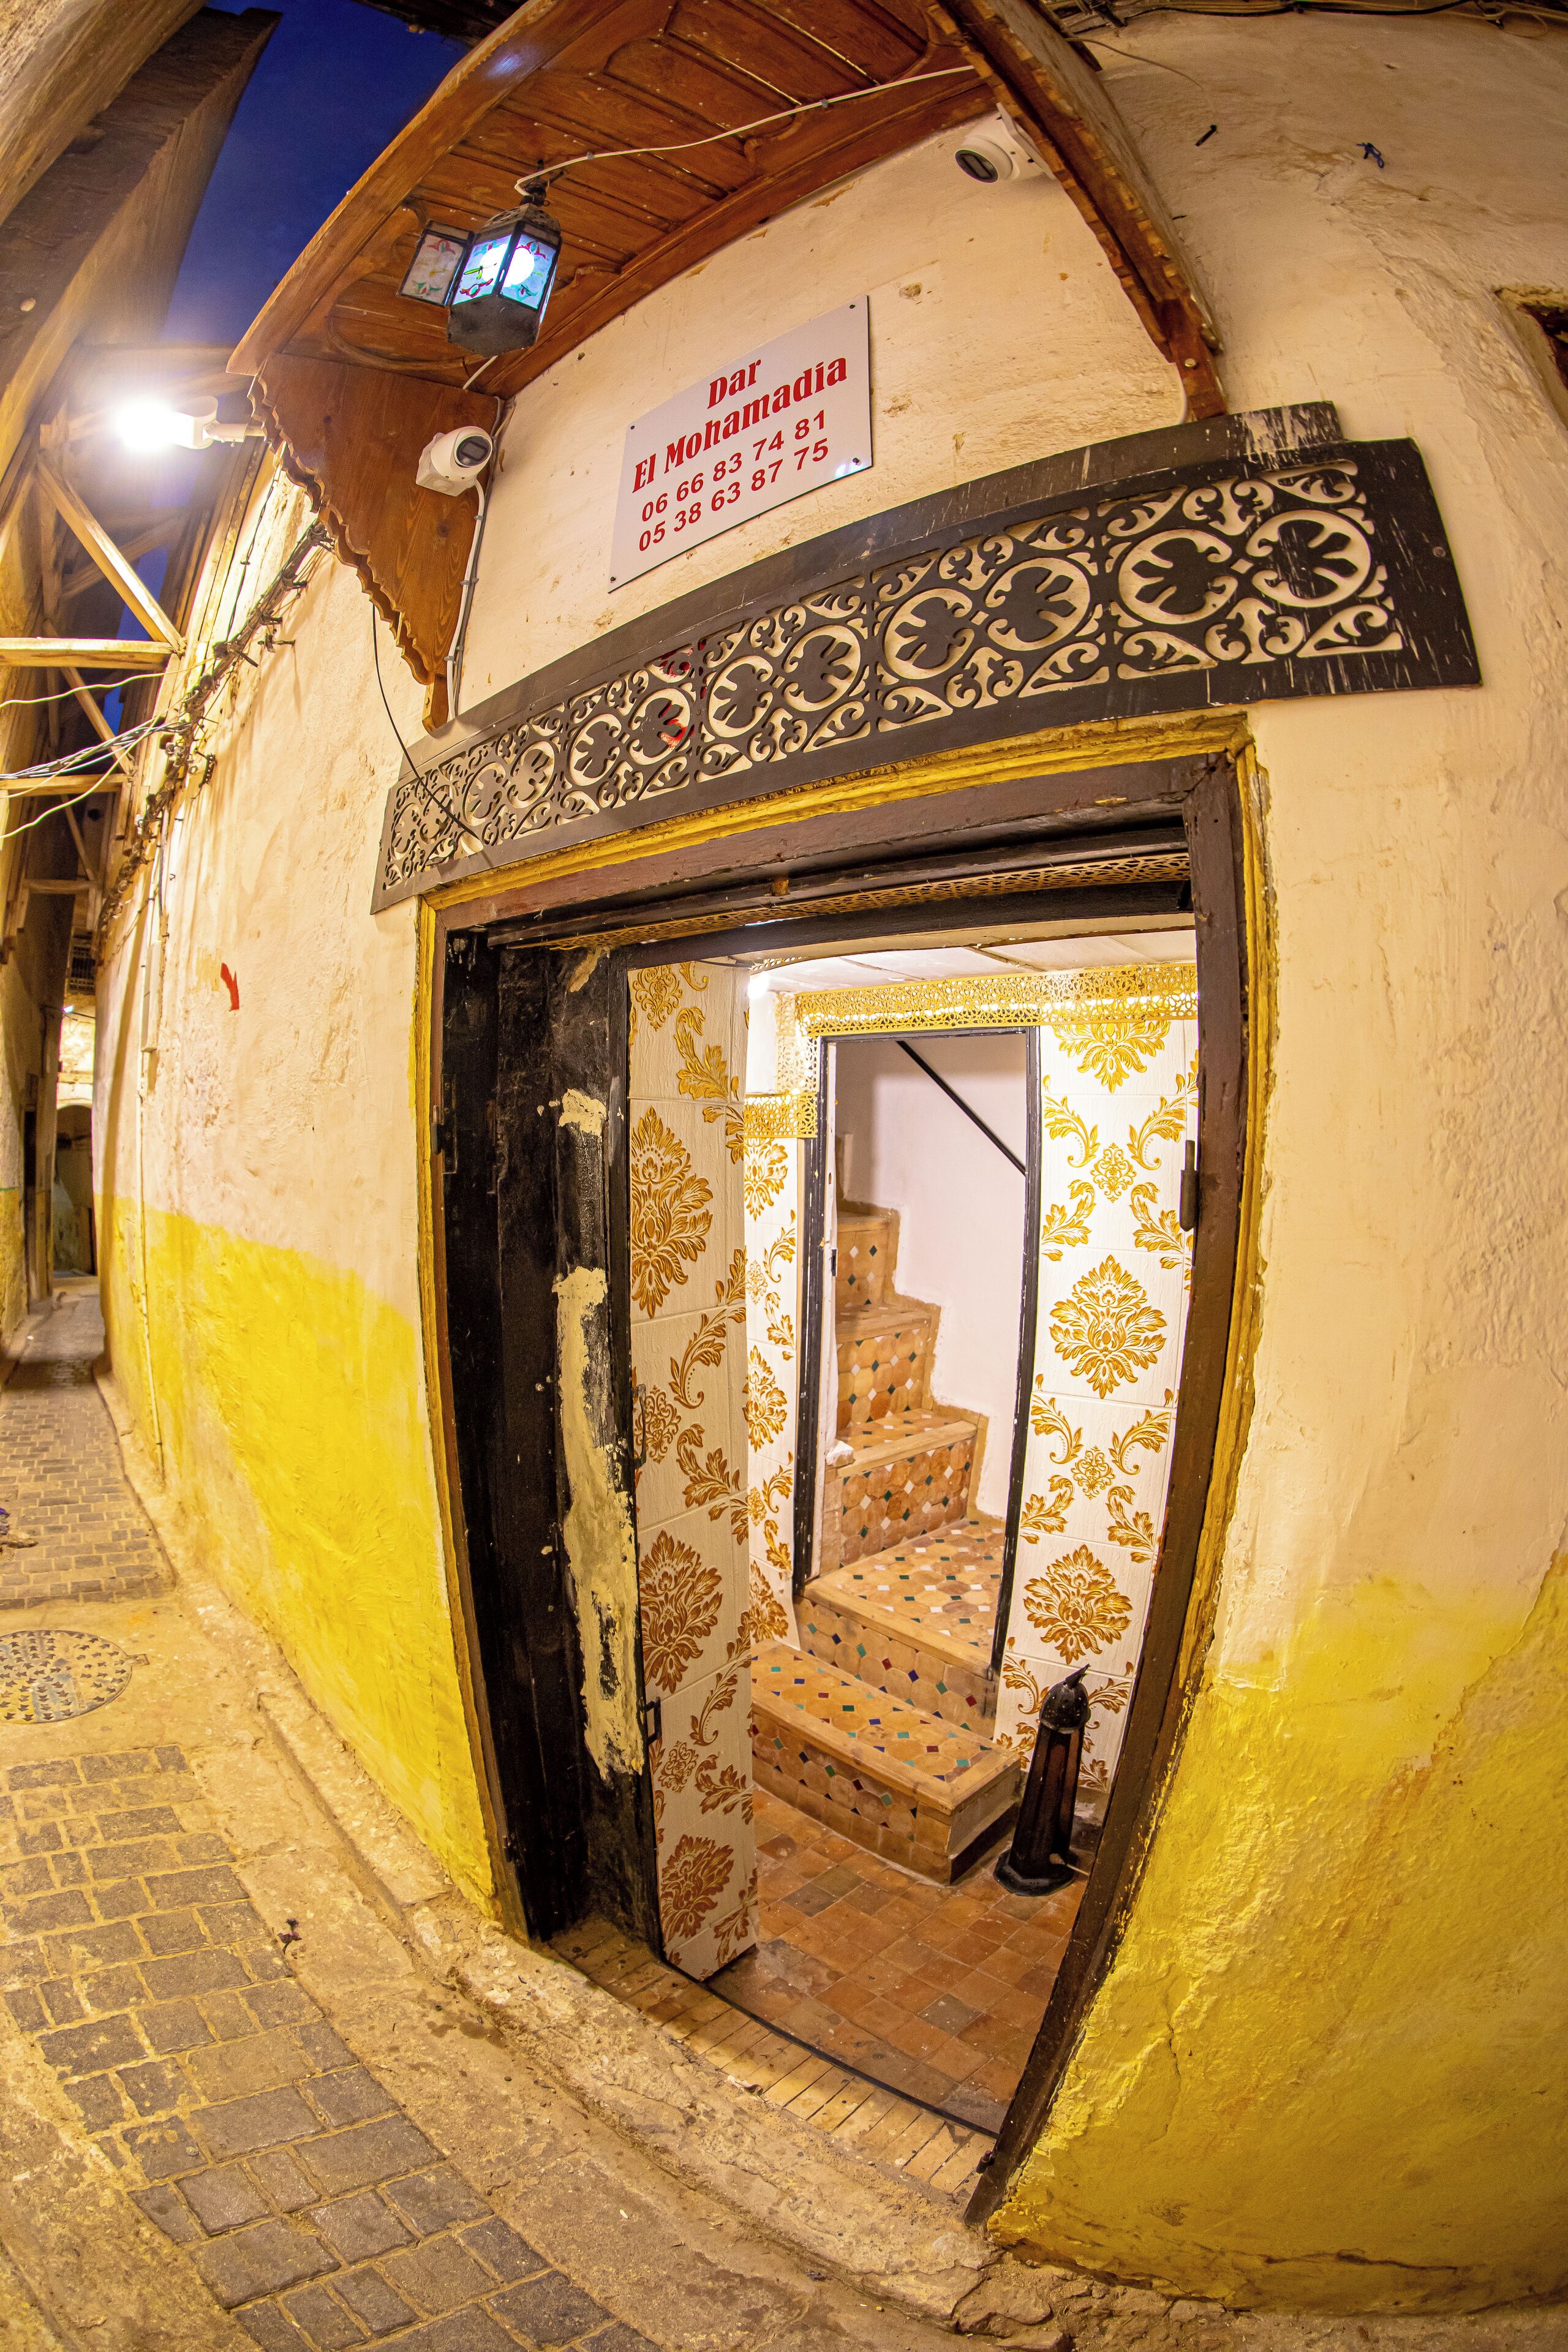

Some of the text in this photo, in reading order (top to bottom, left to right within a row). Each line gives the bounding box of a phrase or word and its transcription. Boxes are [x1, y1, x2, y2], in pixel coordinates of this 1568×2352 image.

[632, 357, 848, 493] El Mohamadia
[707, 360, 762, 410] Dar
[639, 438, 829, 552] 05 38 63 87 75
[641, 410, 824, 522] 06 66 83 74 81
